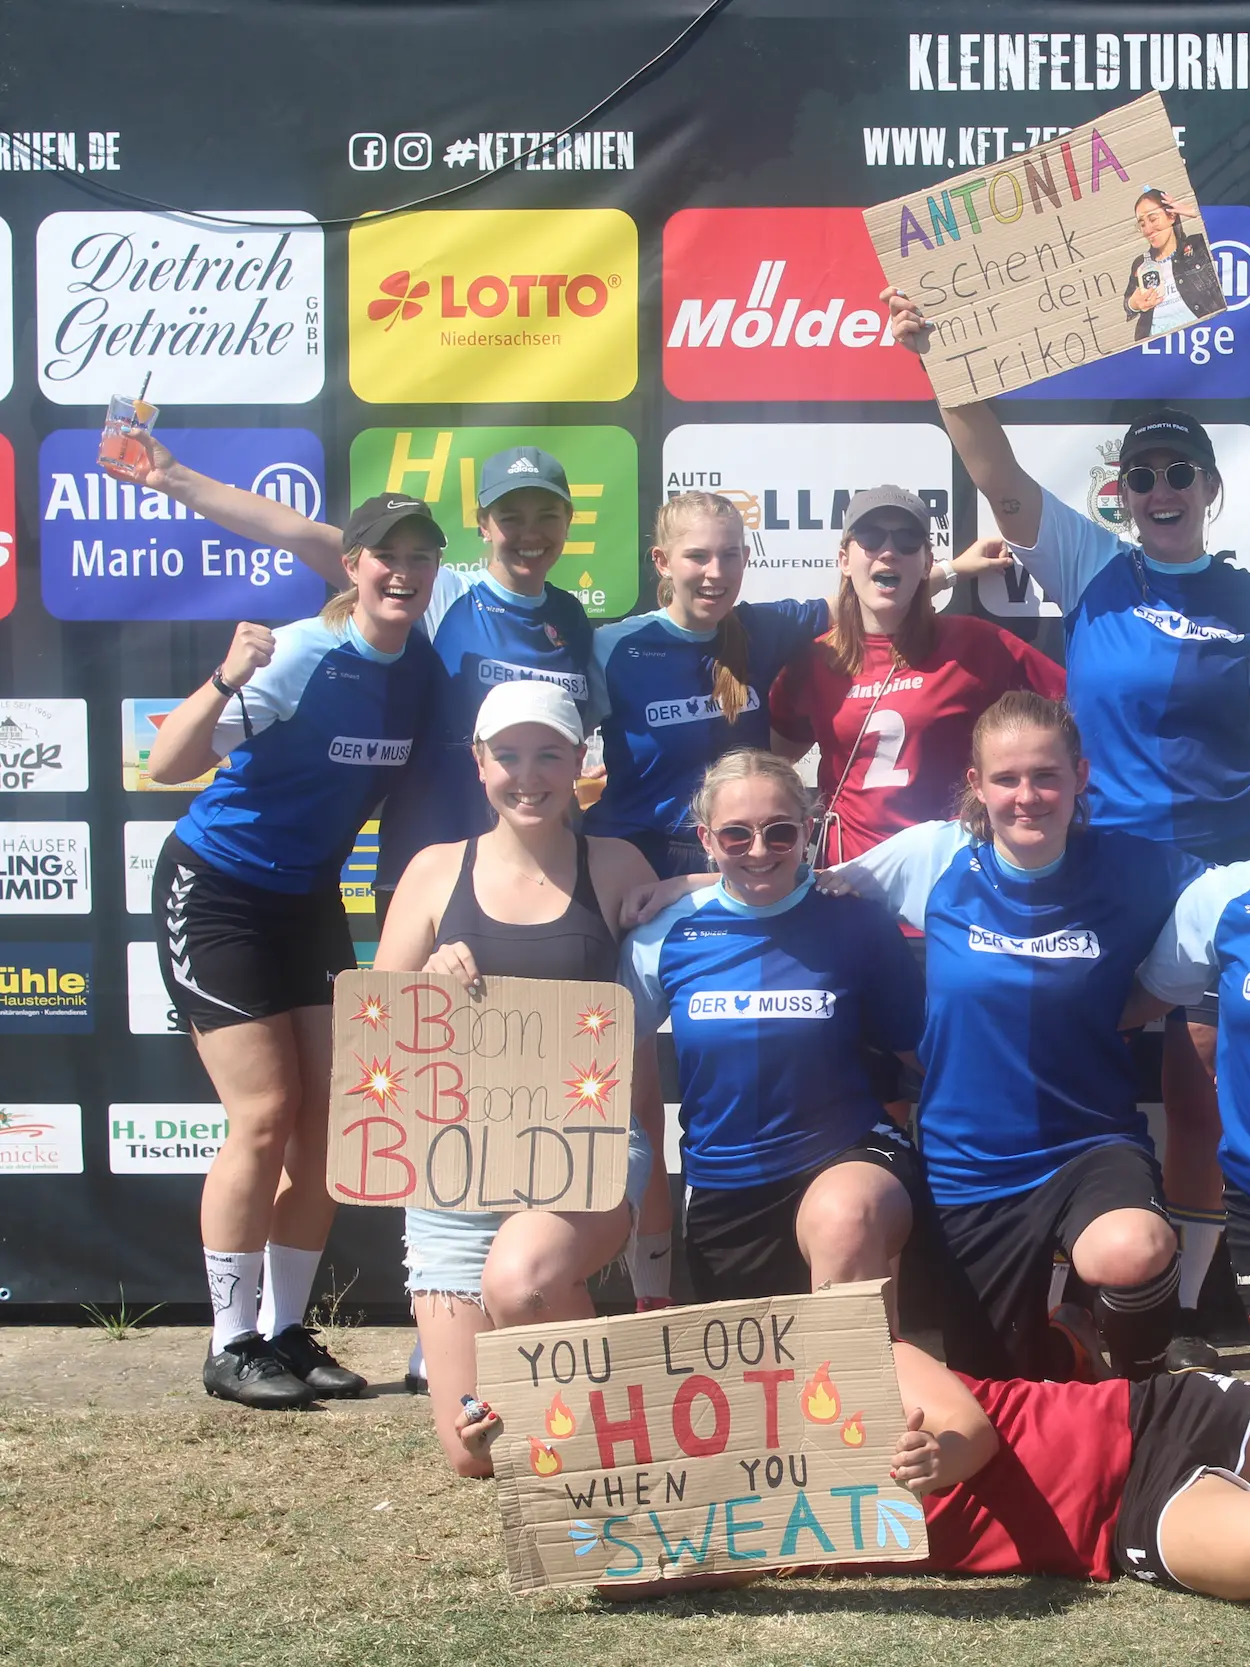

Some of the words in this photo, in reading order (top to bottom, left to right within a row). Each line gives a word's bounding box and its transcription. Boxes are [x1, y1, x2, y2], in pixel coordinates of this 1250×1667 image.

[443, 131, 634, 171] #KFTZERNIEN
[900, 128, 1130, 258] ANTONIA
[67, 231, 295, 294] Dietrich
[1037, 270, 1117, 314] dein
[44, 298, 295, 381] Getränke
[306, 296, 319, 356] GMBH
[440, 330, 562, 347] Niedersachsen
[934, 302, 1001, 348] mir
[946, 308, 1115, 395] Trikot
[507, 465, 540, 475] adidas
[667, 472, 722, 487] AUTO
[72, 537, 185, 578] Mario
[202, 538, 294, 587] Enge
[480, 664, 515, 682] DER
[846, 674, 924, 700] Antoine
[647, 704, 682, 722] DER
[330, 742, 363, 760] DER
[861, 709, 910, 791] 2
[970, 928, 1004, 948] DER
[1030, 935, 1080, 953] MUSS
[395, 984, 546, 1059] Boom
[690, 996, 727, 1014] DER
[758, 995, 813, 1012] MUSS
[414, 1061, 559, 1124] Boom
[112, 1119, 146, 1140] H.
[155, 1118, 229, 1140] Dier
[0, 1145, 59, 1162] nicke
[335, 1116, 627, 1209] BOLDT
[517, 1337, 611, 1387] YOU
[662, 1314, 796, 1377] LOOK
[588, 1368, 795, 1470] HOT
[565, 1470, 687, 1511] WHEN
[739, 1454, 808, 1492] YOU
[603, 1484, 880, 1578] SWEAT
